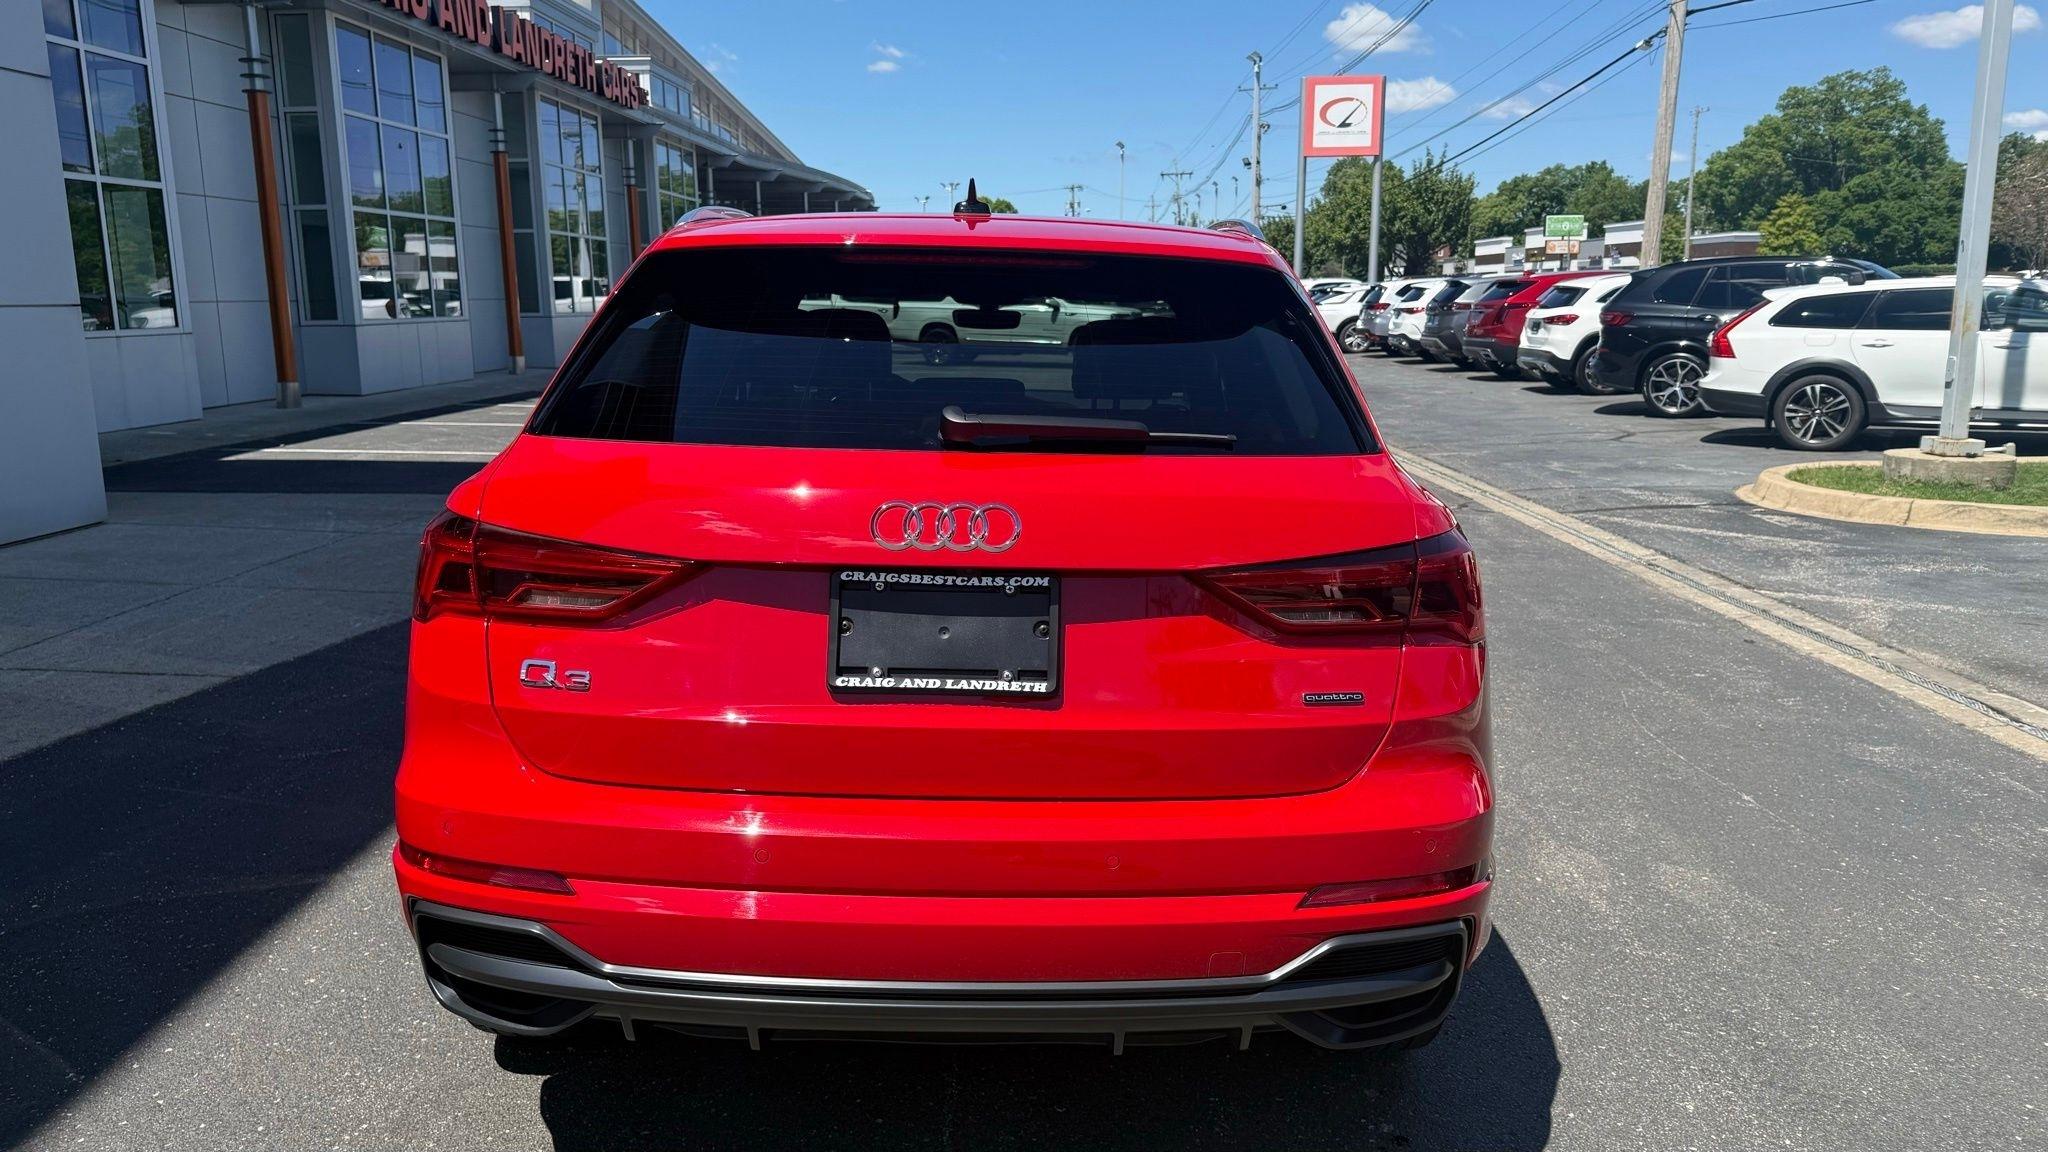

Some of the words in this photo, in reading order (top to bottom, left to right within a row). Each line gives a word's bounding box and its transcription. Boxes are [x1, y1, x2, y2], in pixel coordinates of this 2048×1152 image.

[438, 0, 491, 47] AND
[501, 5, 597, 92] LANDRETH
[602, 60, 639, 109] CARS
[840, 571, 1049, 586] CRAIGSBESTCARS.COM
[520, 659, 591, 692] Q3
[835, 677, 896, 688] CRAIG
[900, 679, 941, 689] AND
[946, 680, 1048, 692] LANDRETH
[1306, 693, 1362, 701] quattro
